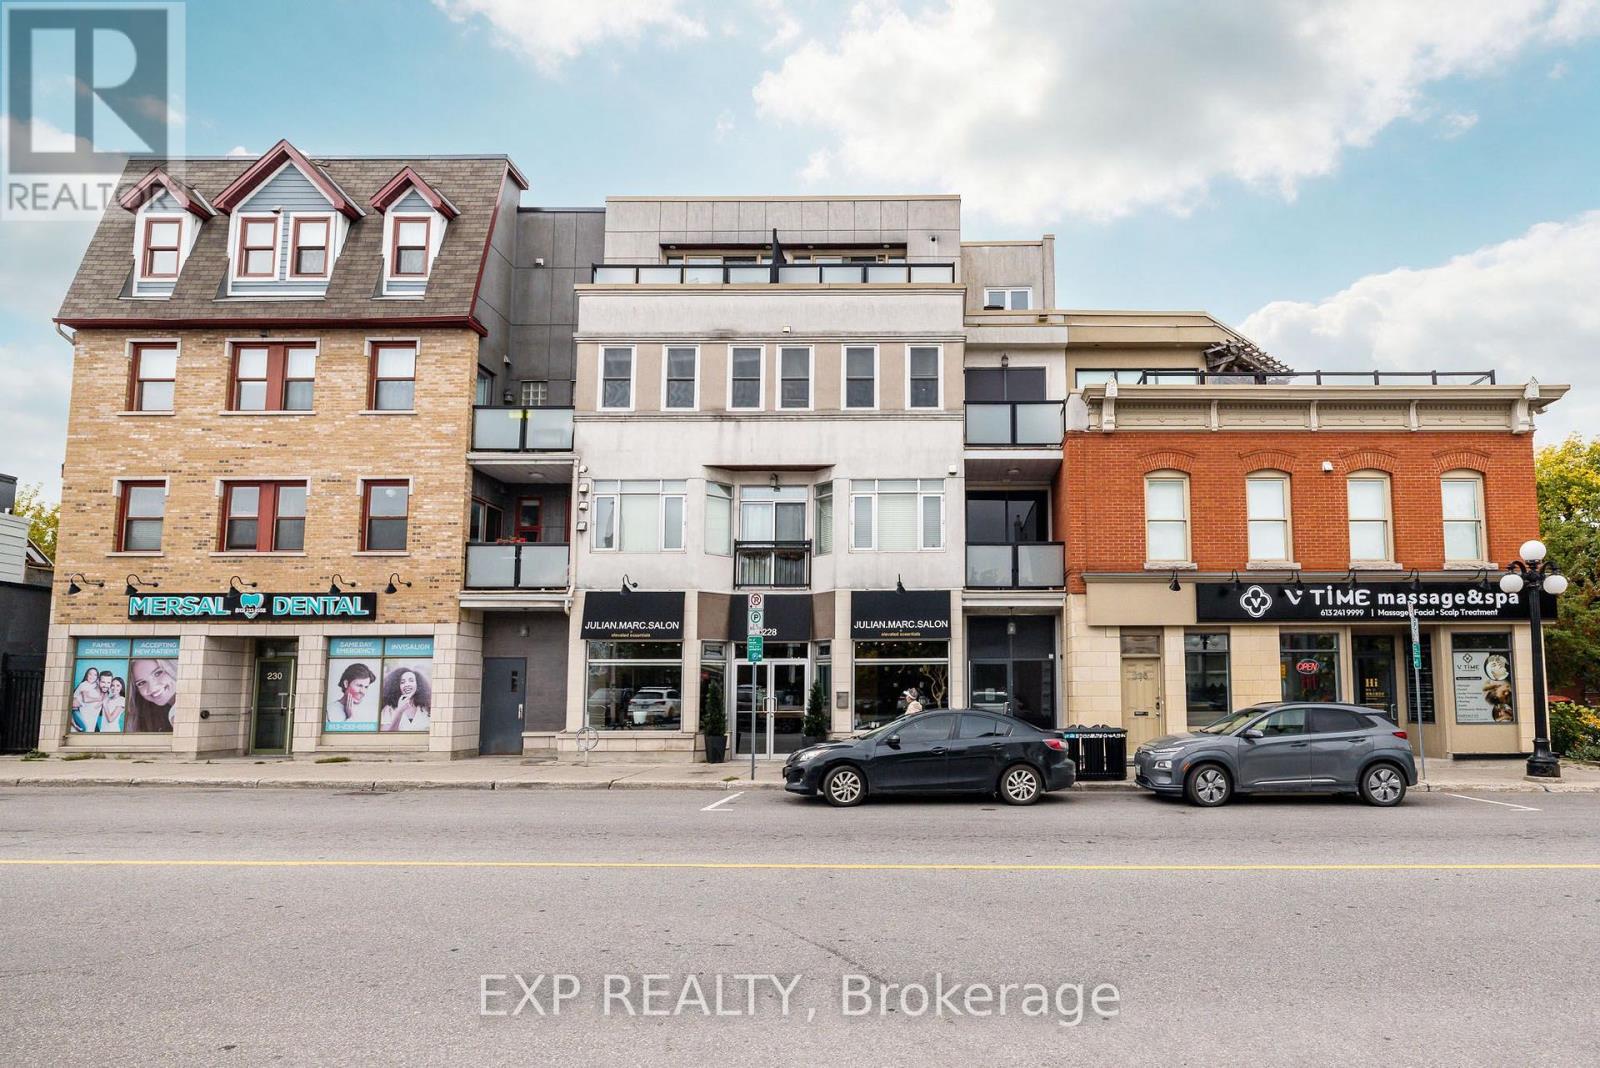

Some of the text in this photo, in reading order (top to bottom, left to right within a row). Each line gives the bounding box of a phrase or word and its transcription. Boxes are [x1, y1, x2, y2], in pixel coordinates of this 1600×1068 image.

[1285, 589, 1303, 606] V
[1378, 589, 1520, 608] massage&spa
[129, 596, 369, 615] MERSAL DENTAL
[1378, 609, 1409, 617] Massage
[1440, 609, 1458, 617] Scalp
[584, 621, 680, 630] JULIAN.MARC.SALON
[853, 620, 949, 629] JULIAN.MARC.SALON
[762, 628, 778, 636] 228
[1296, 662, 1317, 671] OPEN
[267, 672, 282, 680] 230
[1365, 678, 1378, 687] Hi
